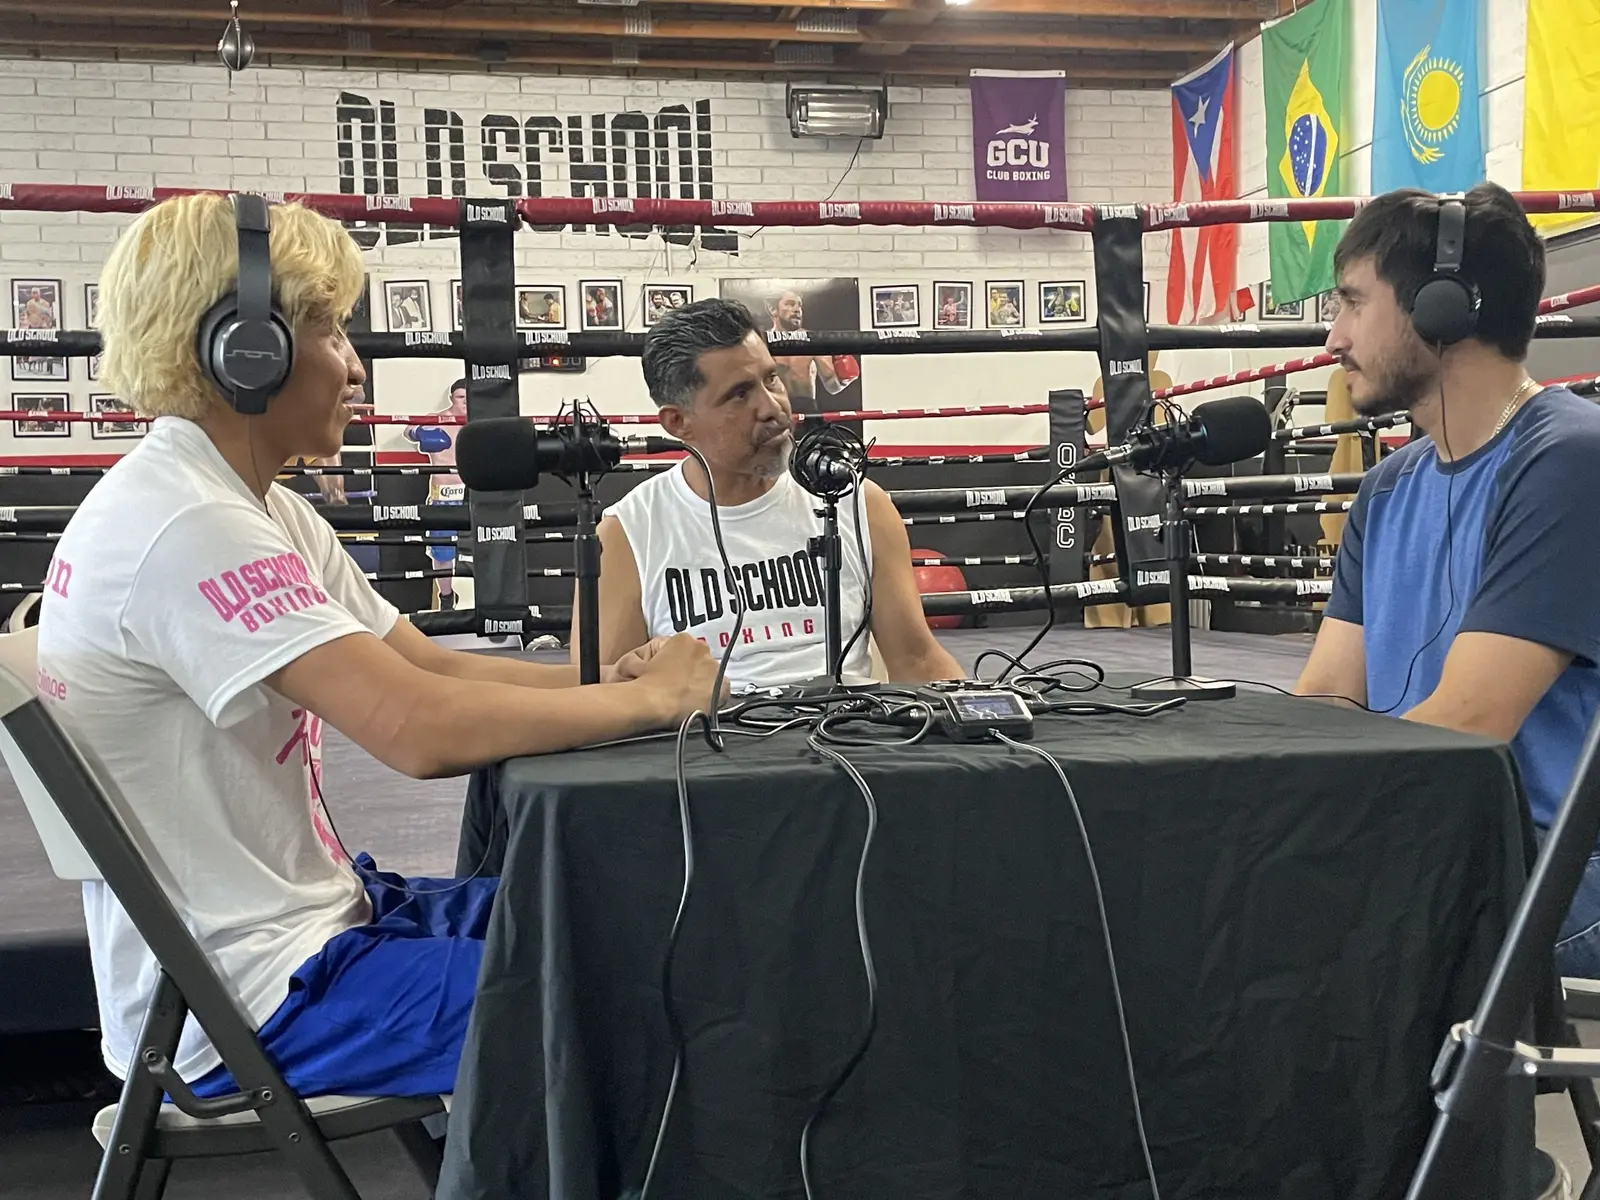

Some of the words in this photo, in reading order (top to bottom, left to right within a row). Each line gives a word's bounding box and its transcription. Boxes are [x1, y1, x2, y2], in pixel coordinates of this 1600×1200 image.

[987, 139, 1050, 168] GCU
[987, 170, 1010, 181] CLUB
[1013, 171, 1051, 181] BOXING
[107, 185, 122, 201] OLD
[122, 186, 155, 201] SCHOOL
[366, 195, 382, 212] OLD
[382, 196, 413, 212] SCHOOL
[592, 199, 608, 214] OLD
[711, 201, 726, 216] OLD
[727, 202, 754, 216] SCHOOL
[819, 203, 833, 219] OLD
[467, 204, 481, 222] OLD
[481, 206, 507, 223] SCHOOL
[934, 204, 949, 221] OLD
[1045, 206, 1059, 223] OLD
[1101, 205, 1114, 220] OLD
[8, 330, 25, 343] OLD
[25, 330, 58, 342] SCHOOL
[405, 332, 421, 346] OLD
[421, 332, 452, 346] SCHOOL
[525, 332, 541, 345] OLD
[541, 332, 571, 345] SCHOOL
[767, 330, 782, 343] OLD
[472, 364, 485, 380] OLD
[485, 364, 511, 380] SCHOOL
[1109, 360, 1123, 376] OLD
[1123, 359, 1145, 374] SCHOOL
[440, 486, 463, 498] Coro
[1187, 481, 1201, 498] OLD
[1294, 476, 1308, 492] OLD
[965, 490, 980, 507] OLD
[1077, 486, 1091, 502] OLD
[373, 505, 389, 522] OLD
[389, 505, 421, 520] SCHOOL
[478, 526, 491, 542] OLD
[491, 526, 517, 542] SCHOOL
[198, 570, 250, 623] OLD
[665, 568, 724, 633] OLD
[239, 586, 328, 633] BOXING
[484, 619, 499, 634] OLD
[499, 619, 524, 634] SCHOOL
